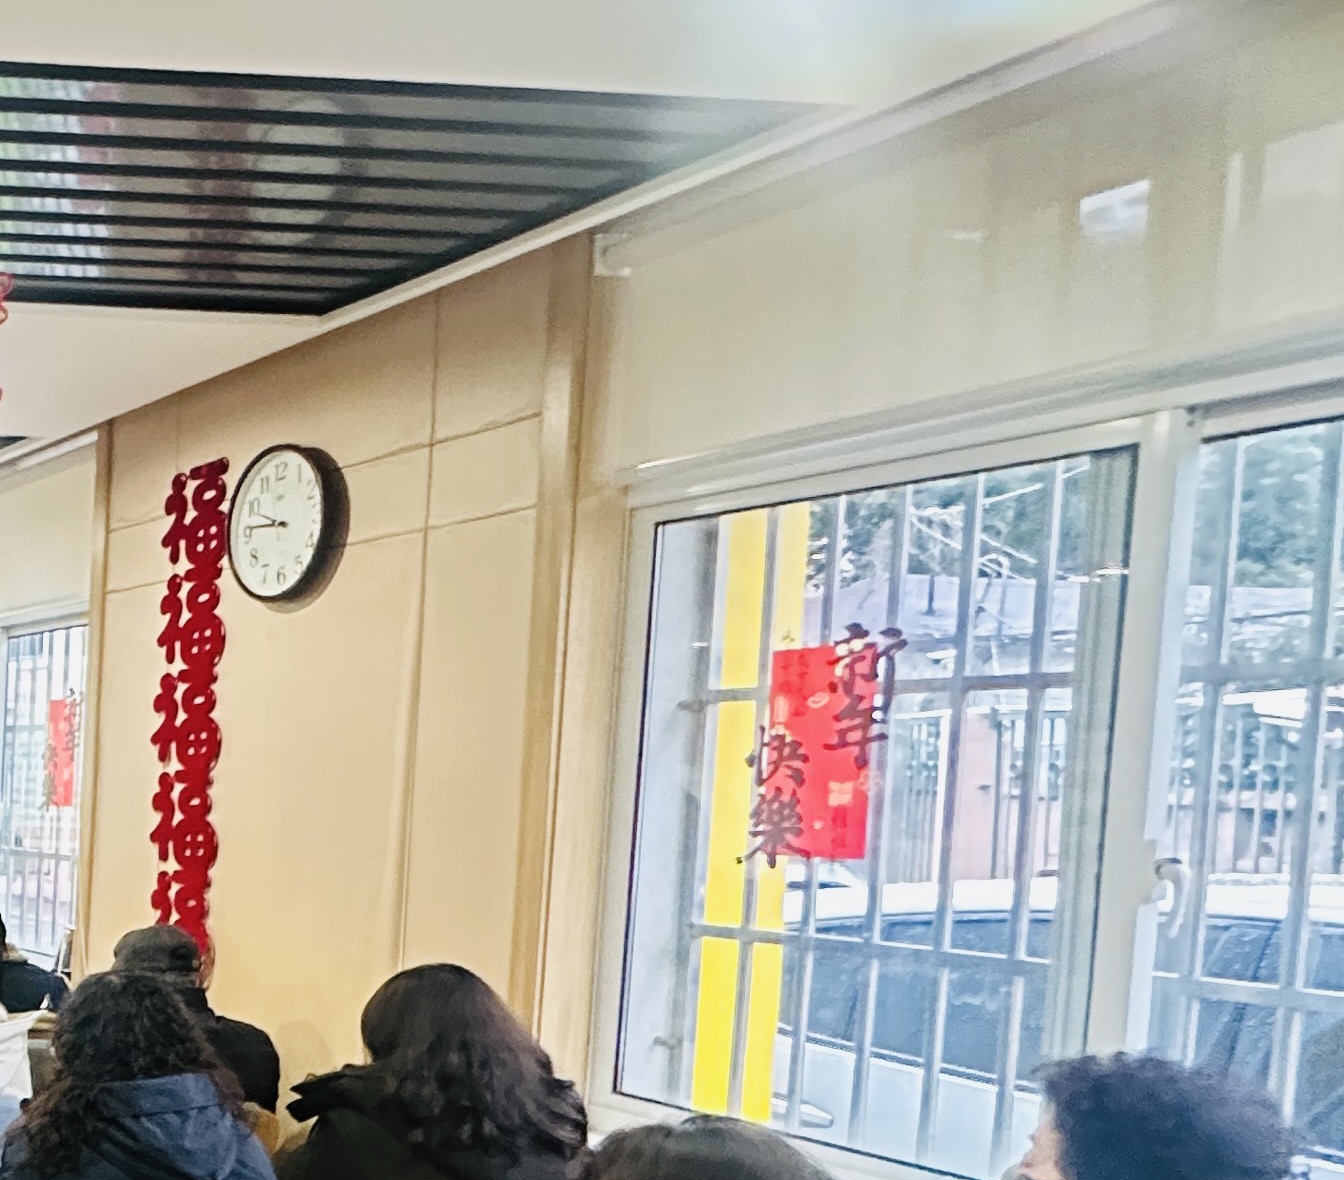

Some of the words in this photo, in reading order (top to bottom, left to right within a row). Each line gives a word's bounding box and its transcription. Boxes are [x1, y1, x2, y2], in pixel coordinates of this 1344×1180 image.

[274, 460, 289, 482] 12
[296, 463, 303, 484] 1
[259, 476, 270, 495] 11
[248, 497, 261, 518] 10
[243, 525, 253, 545] 9
[249, 547, 259, 568] 8
[261, 563, 270, 584] 7
[276, 565, 287, 586] 6
